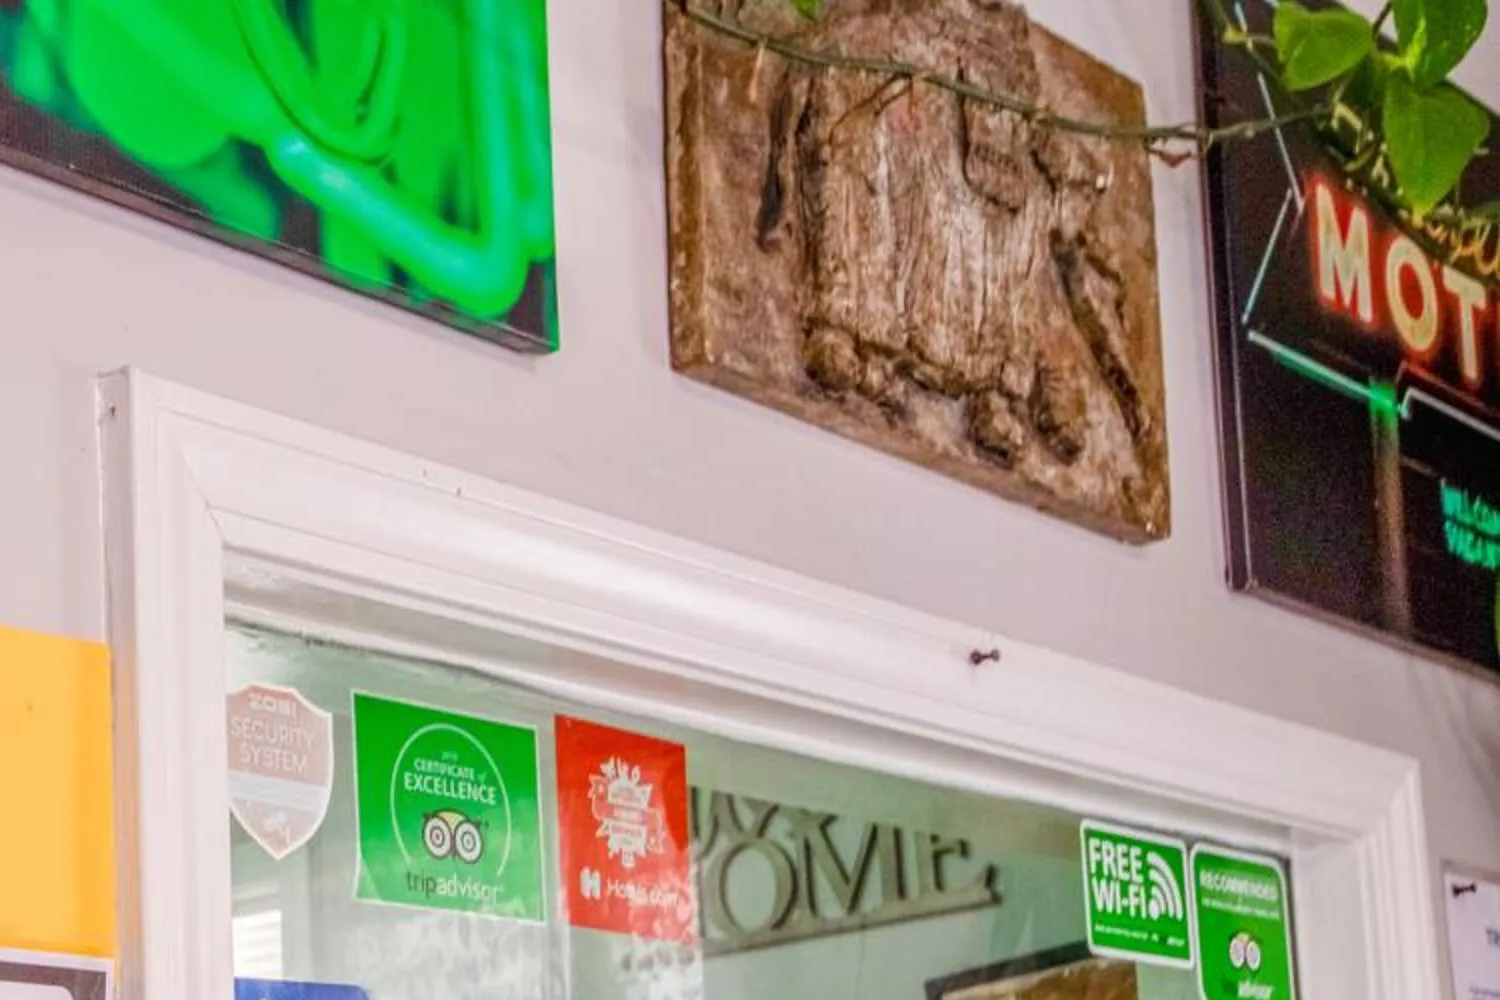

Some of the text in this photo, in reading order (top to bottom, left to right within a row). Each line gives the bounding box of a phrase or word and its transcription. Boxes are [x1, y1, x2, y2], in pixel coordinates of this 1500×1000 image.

[229, 715, 316, 749] SECURITY
[239, 741, 308, 776] SYSTEM
[413, 757, 475, 781] CERTIFICATE
[404, 771, 497, 806] EXCELLENCE
[1089, 838, 1143, 882] FREE
[406, 869, 499, 904] tripadvisor
[1092, 877, 1146, 919] WI-FI
